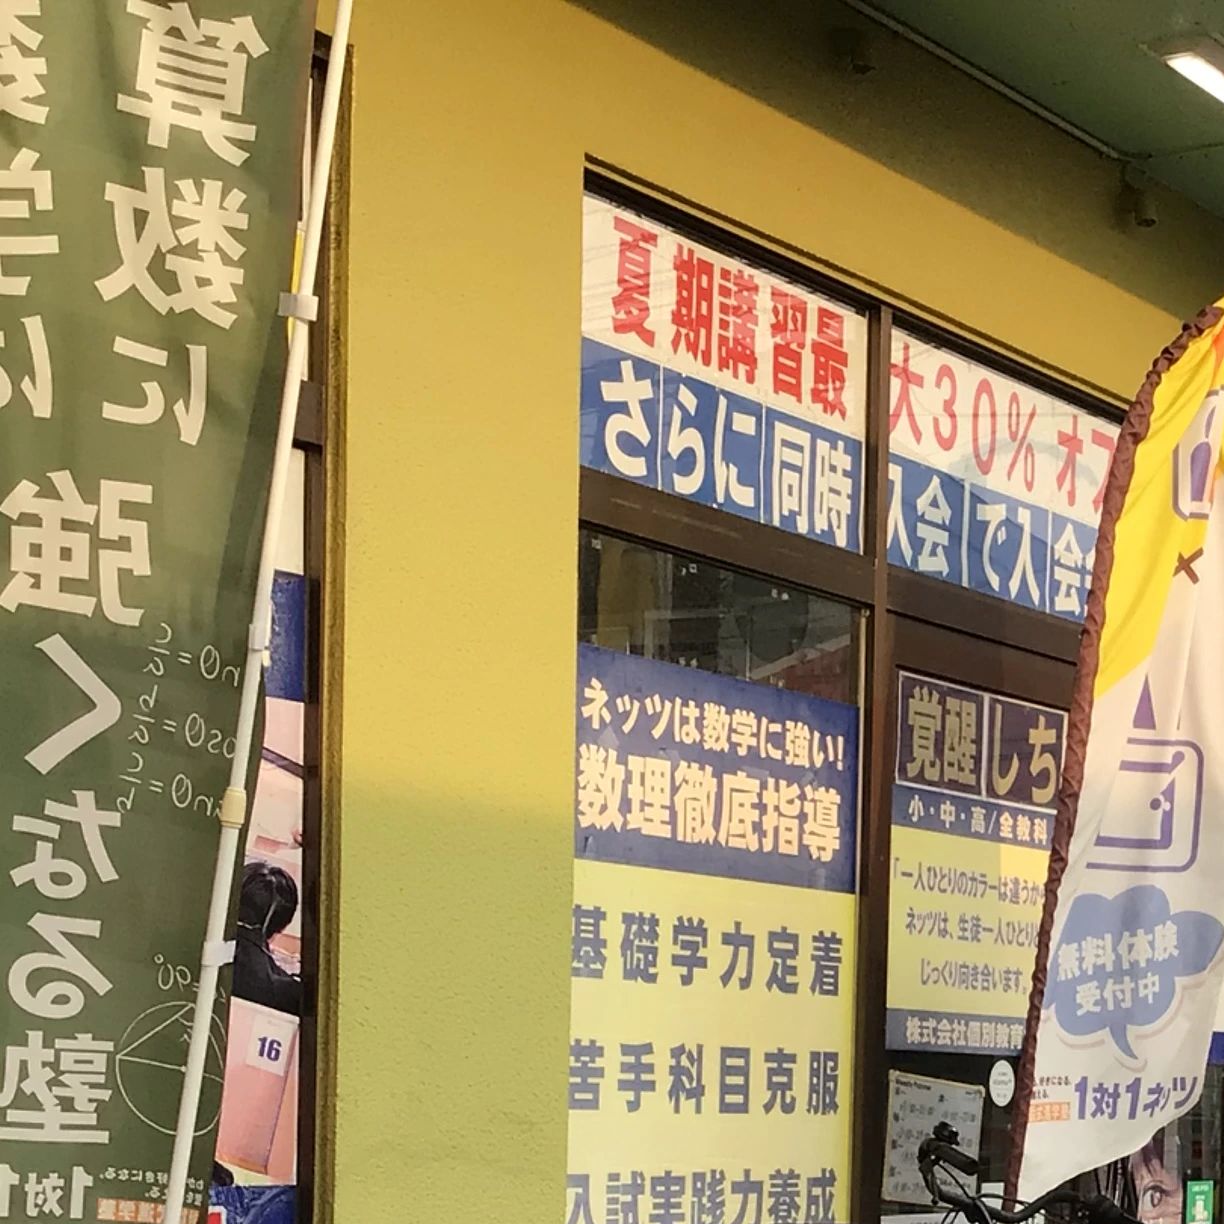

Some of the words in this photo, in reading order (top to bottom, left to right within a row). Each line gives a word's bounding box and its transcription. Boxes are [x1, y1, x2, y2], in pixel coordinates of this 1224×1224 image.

[611, 215, 848, 420] 夏期講習最
[600, 360, 852, 549] さらに同時
[887, 461, 1095, 616] 入会で入会
[581, 678, 844, 772] ネッツは数学に強い!
[578, 743, 842, 863] 数理徹底指導
[573, 904, 842, 997] 基礎学力定着
[1057, 920, 1180, 983] 無料体験
[1075, 971, 1160, 1016] 受付中
[257, 1035, 282, 1063] 16
[569, 1038, 840, 1118] 苦手科目克服
